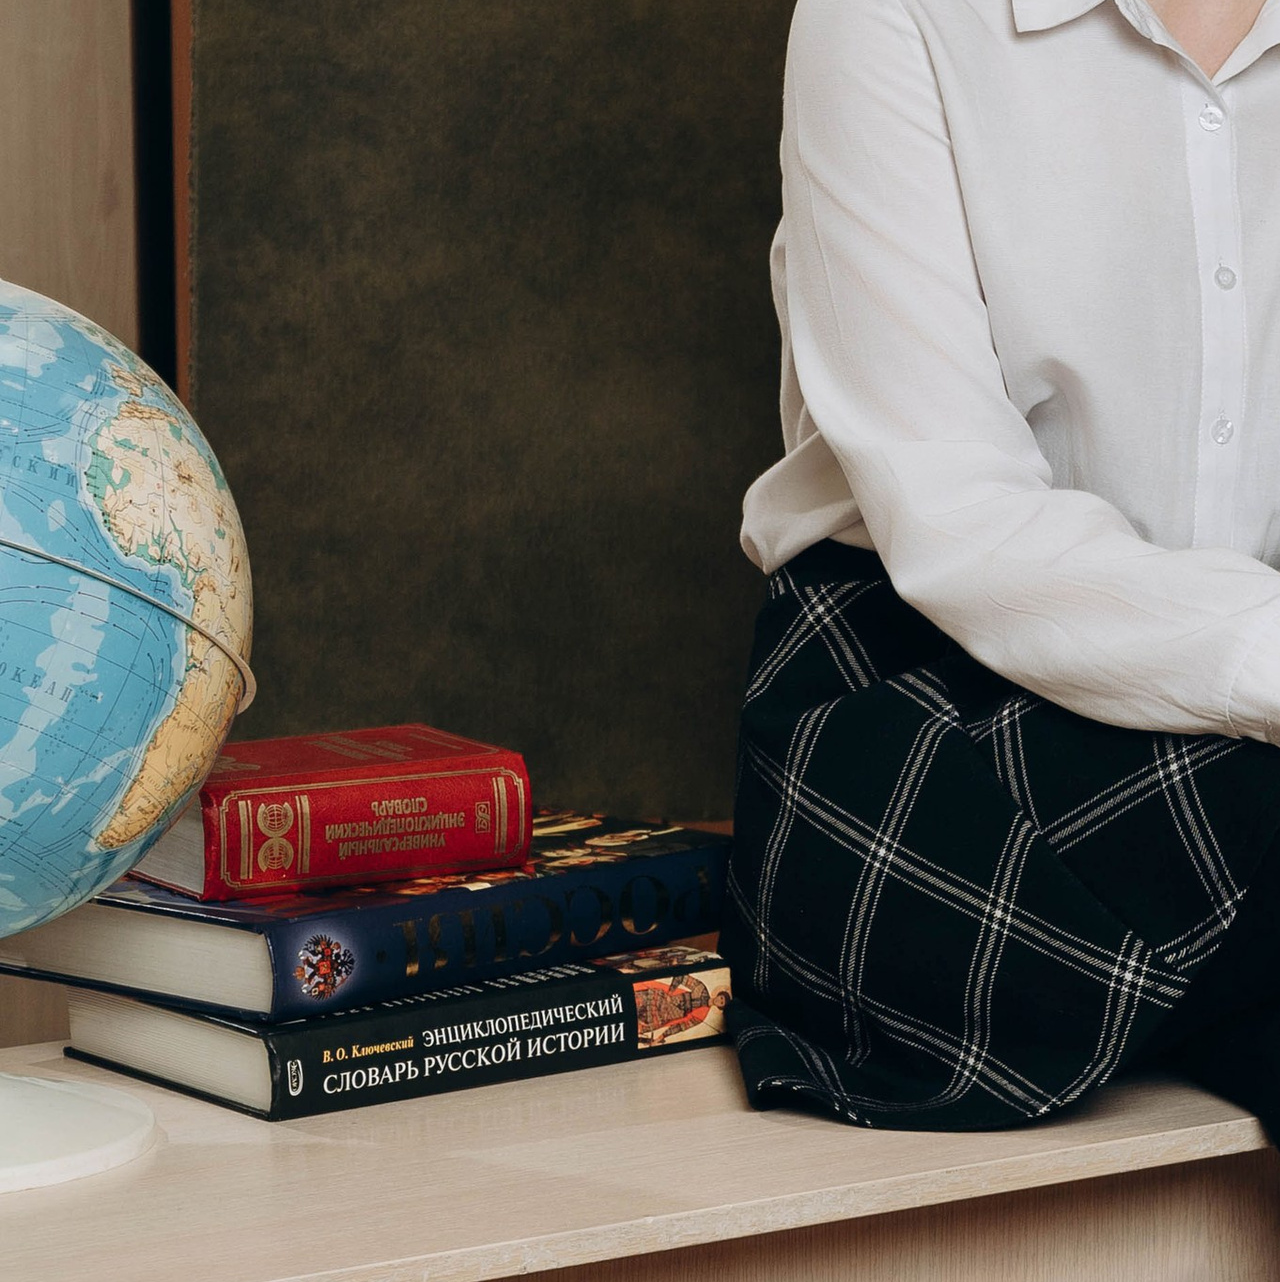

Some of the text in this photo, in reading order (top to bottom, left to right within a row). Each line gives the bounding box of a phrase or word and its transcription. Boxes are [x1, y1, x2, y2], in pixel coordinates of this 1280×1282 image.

[371, 797, 428, 817] СЛОВАРЬ
[325, 811, 466, 843] ЭНЦИКЛОПЕДИЧЕСКИЙ
[338, 832, 446, 860] УНИВЕРСАЛЬНЫЙ
[422, 994, 624, 1048] ЭНЦИКЛОПЕДИЧЕСКИЙ
[322, 1035, 415, 1064] В. О. Ключевский
[323, 1022, 626, 1095] СЛОВАРЬ РУССКОЙ ИСТОРИИ
